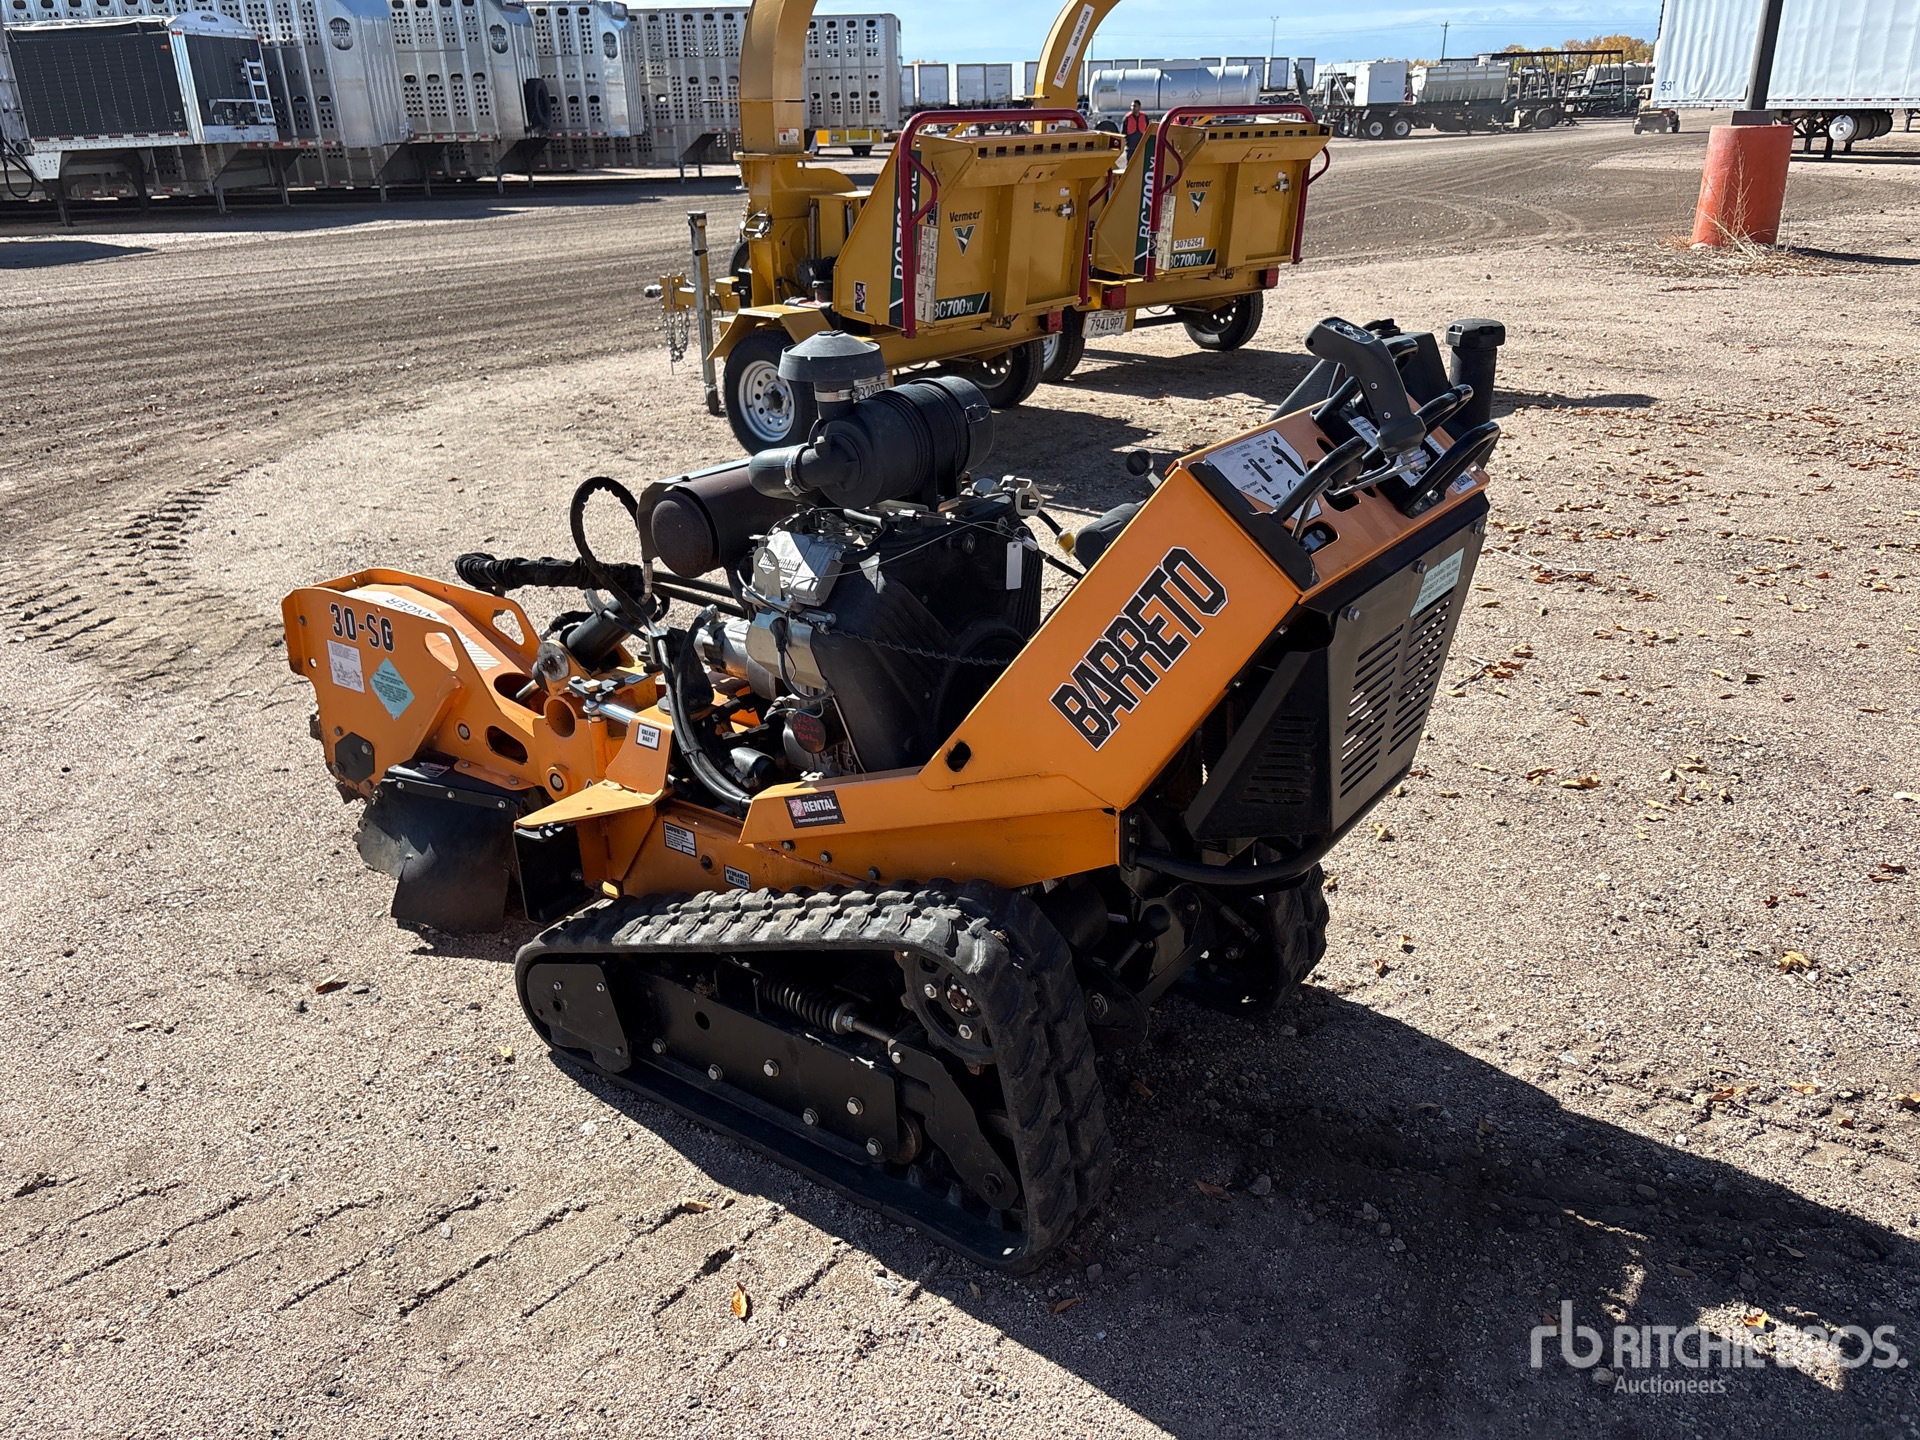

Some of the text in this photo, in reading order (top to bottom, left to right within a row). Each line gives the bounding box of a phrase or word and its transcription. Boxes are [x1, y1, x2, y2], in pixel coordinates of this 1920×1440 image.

[1186, 180, 1212, 188] Vermeer
[950, 211, 980, 222] Vermeer
[1175, 239, 1202, 249] 3076264
[1090, 317, 1124, 331] 79419PT
[330, 602, 394, 653] 30-SG
[1049, 546, 1228, 752] BARRETO
[802, 799, 836, 812] RENTAL
